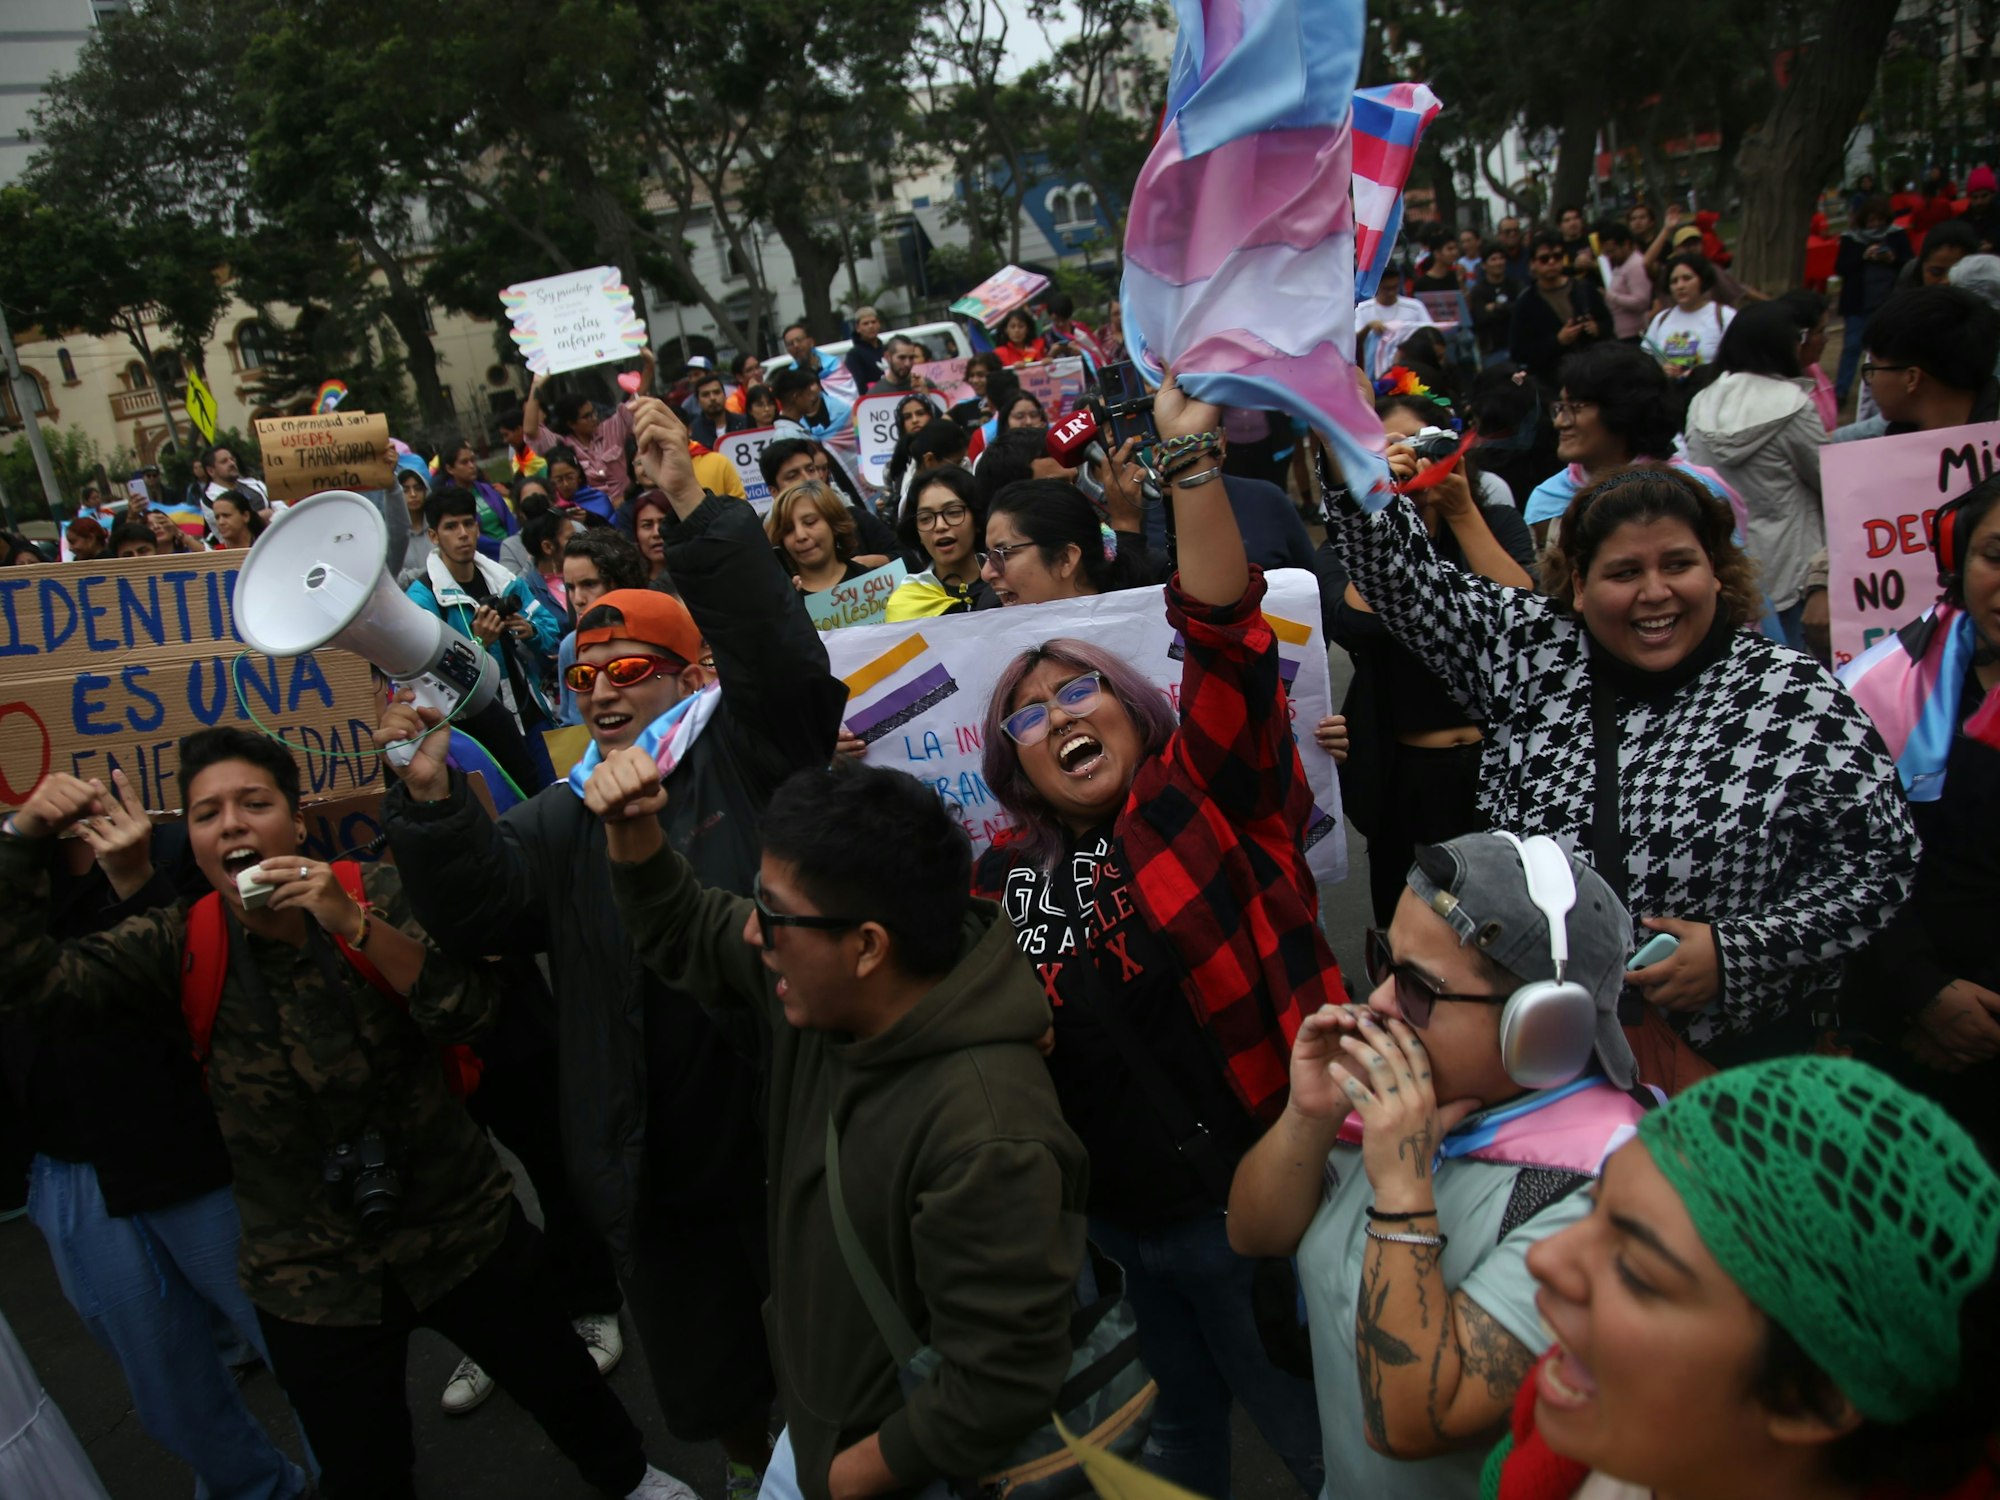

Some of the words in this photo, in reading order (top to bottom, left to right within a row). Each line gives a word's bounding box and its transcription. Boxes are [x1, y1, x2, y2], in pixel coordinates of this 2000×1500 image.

[553, 325, 569, 335] no
[258, 422, 275, 434] La
[869, 409, 890, 423] NO
[266, 454, 284, 467] la
[295, 441, 377, 468] TRANSFOBIA
[1938, 440, 2000, 494] Mi
[312, 470, 362, 490] mata
[831, 585, 858, 607] Soy
[863, 573, 894, 604] gay
[1853, 569, 1905, 613] NO
[71, 665, 165, 735] ES
[186, 652, 335, 727] UNA
[904, 730, 945, 762] LA
